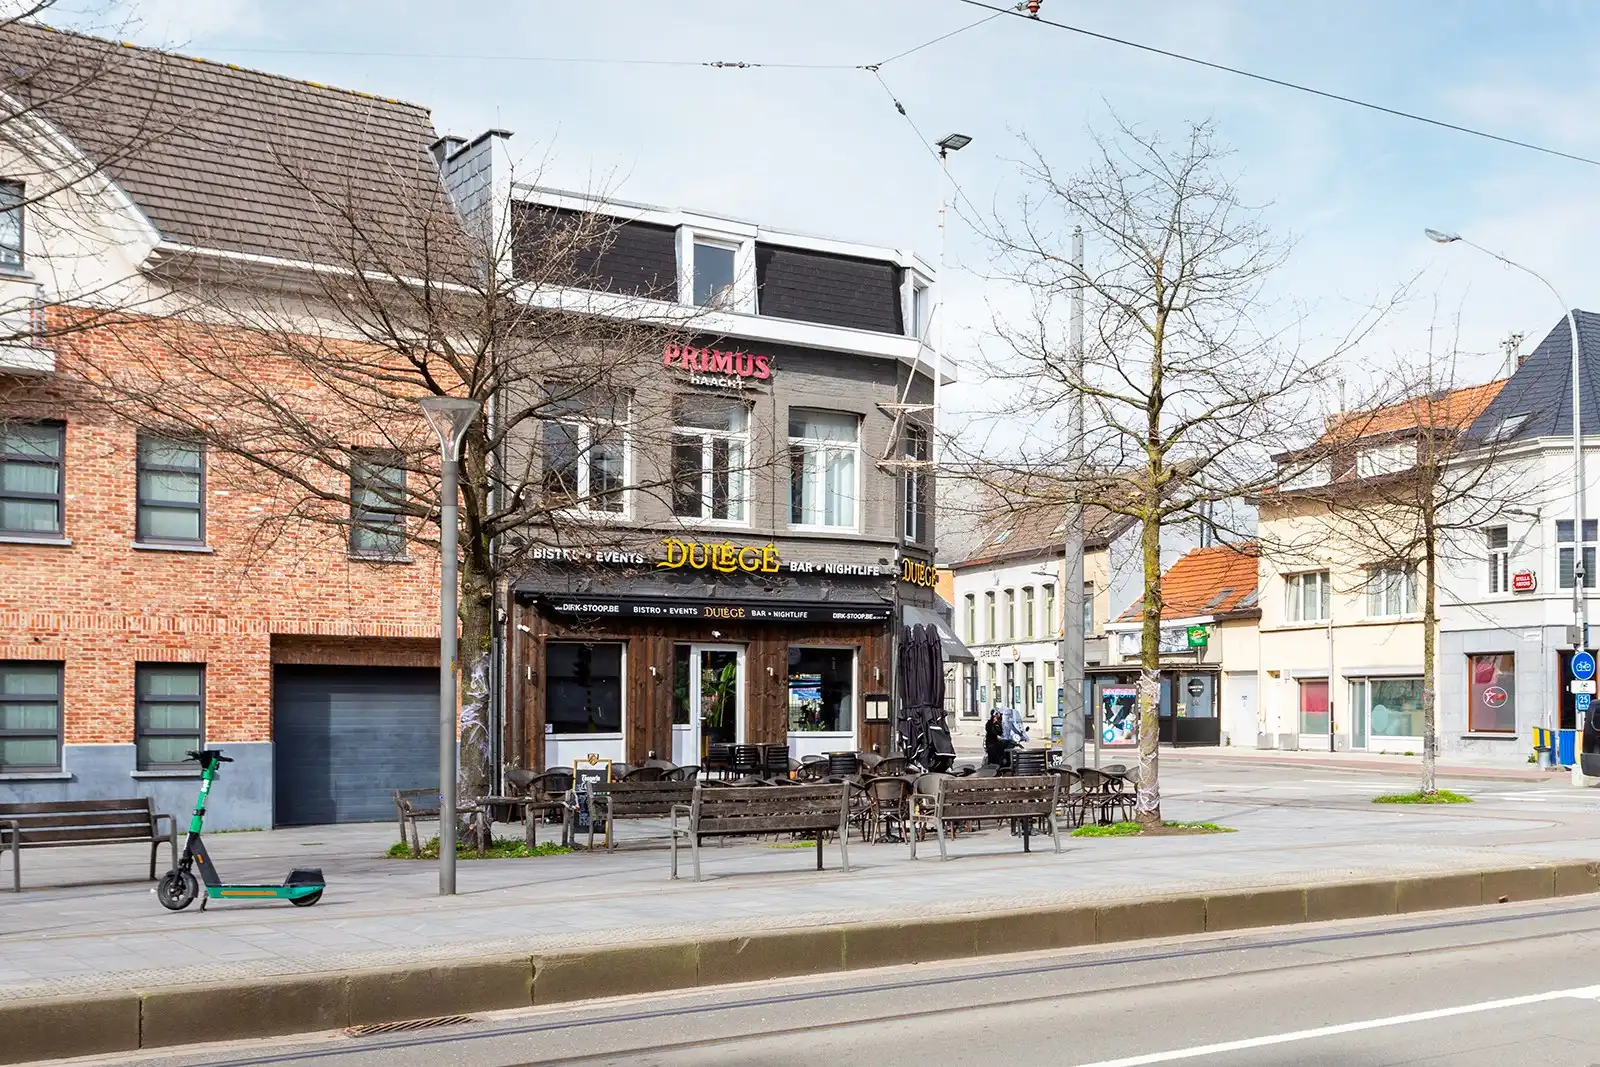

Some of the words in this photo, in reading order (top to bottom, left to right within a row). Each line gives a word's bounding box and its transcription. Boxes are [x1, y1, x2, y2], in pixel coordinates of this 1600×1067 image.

[663, 343, 771, 379] PRIMUS
[690, 376, 745, 389] HAACHT
[595, 551, 644, 564] EVENTS
[790, 561, 813, 573] BAR
[825, 563, 880, 576] NIGHTLIFE
[633, 606, 661, 614] BISTRO
[669, 607, 698, 615] EVENTS
[751, 609, 767, 617] BAR
[773, 611, 808, 619] NIGHTLIFE
[1579, 695, 1588, 704] 25
